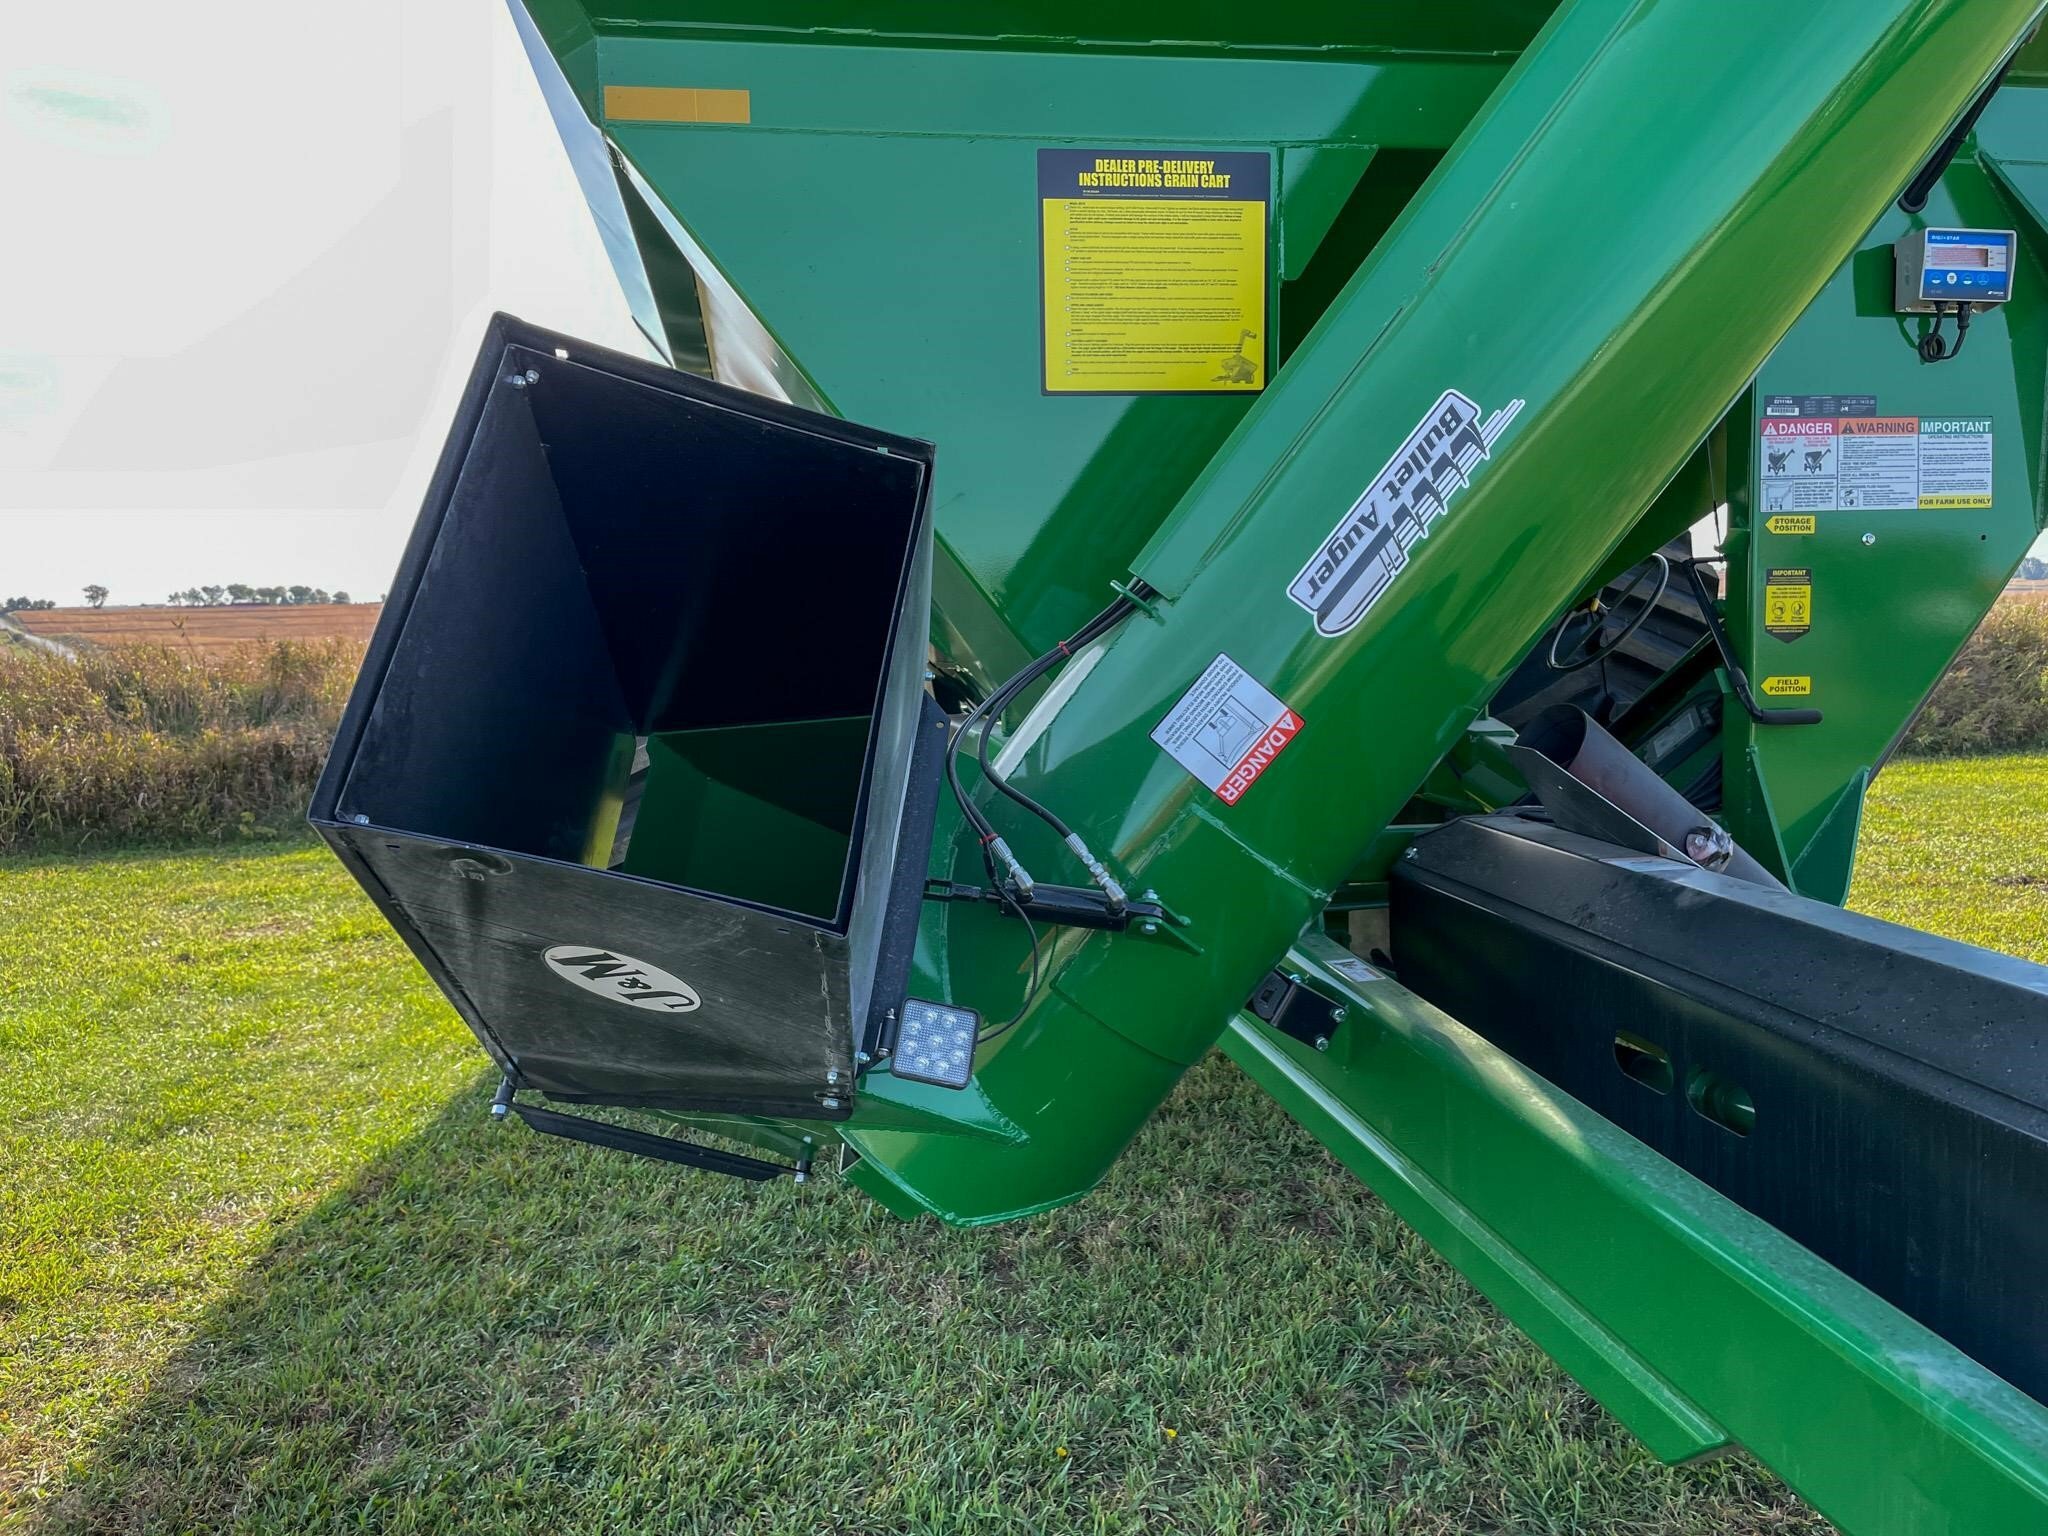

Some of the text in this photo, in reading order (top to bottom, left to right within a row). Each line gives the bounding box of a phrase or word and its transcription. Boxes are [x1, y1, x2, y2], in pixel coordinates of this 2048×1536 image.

[1095, 159, 1214, 174] DEALER PRE-DELIVERY
[1078, 173, 1231, 188] INSTRUCTIONS GRAIN CART
[1779, 422, 1833, 434] DANGER
[1857, 422, 1914, 433] WARNING
[1921, 421, 1990, 432] IMPORTANT
[1308, 403, 1463, 599] Bullet Auger
[1220, 730, 1287, 800] DANGER
[550, 952, 695, 1009] J&M
